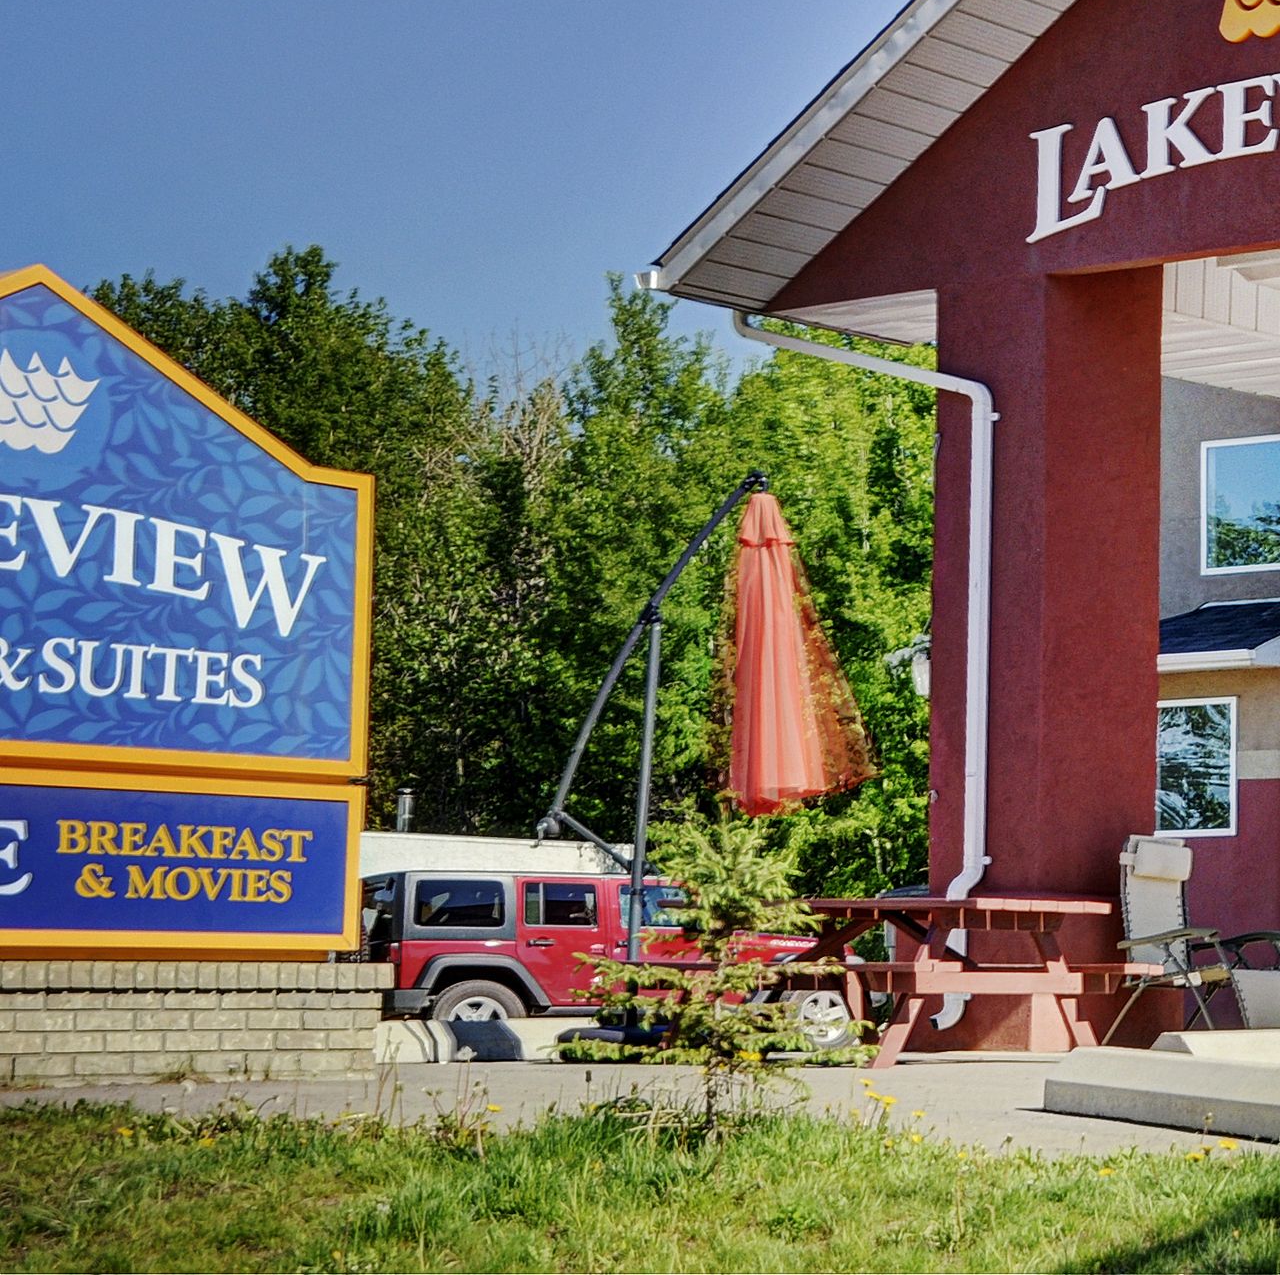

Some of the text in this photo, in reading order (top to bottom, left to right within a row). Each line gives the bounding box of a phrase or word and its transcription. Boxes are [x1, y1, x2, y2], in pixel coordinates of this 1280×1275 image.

[38, 637, 263, 708] SUITES
[56, 819, 312, 862] BREAKFAST
[75, 863, 292, 903] & MOVIES
